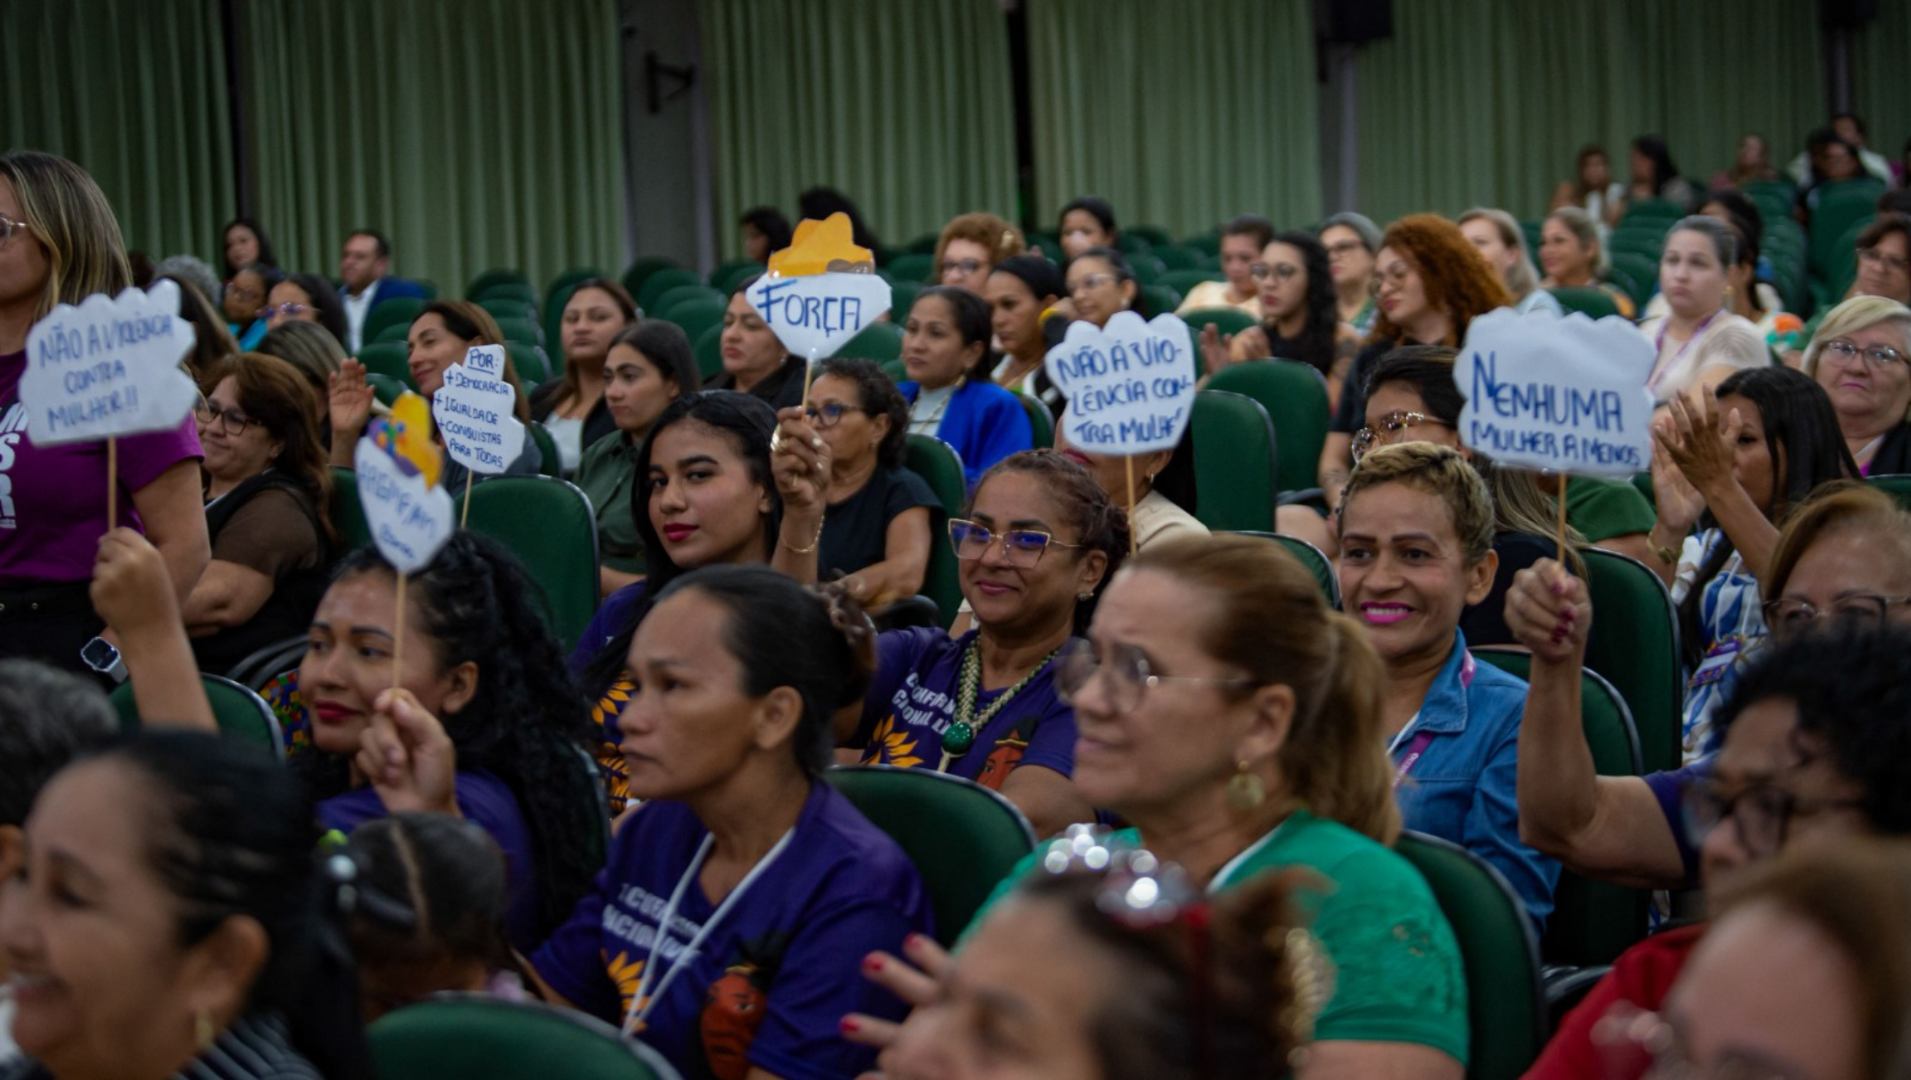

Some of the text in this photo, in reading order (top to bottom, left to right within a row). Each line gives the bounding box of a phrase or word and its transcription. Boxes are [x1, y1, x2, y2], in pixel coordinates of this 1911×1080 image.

[757, 279, 861, 337] FORÇA
[39, 323, 83, 368] NÃO
[64, 359, 126, 394] CONTRA
[1056, 345, 1107, 385] NÃO
[456, 372, 509, 396] DEMOCRACIA
[1473, 351, 1623, 433] NENHUMA
[444, 396, 498, 425] IGUALDADE
[449, 438, 471, 457] PARA
[1074, 420, 1115, 443] TRA
[1471, 420, 1641, 467] MULHER A MENOS
